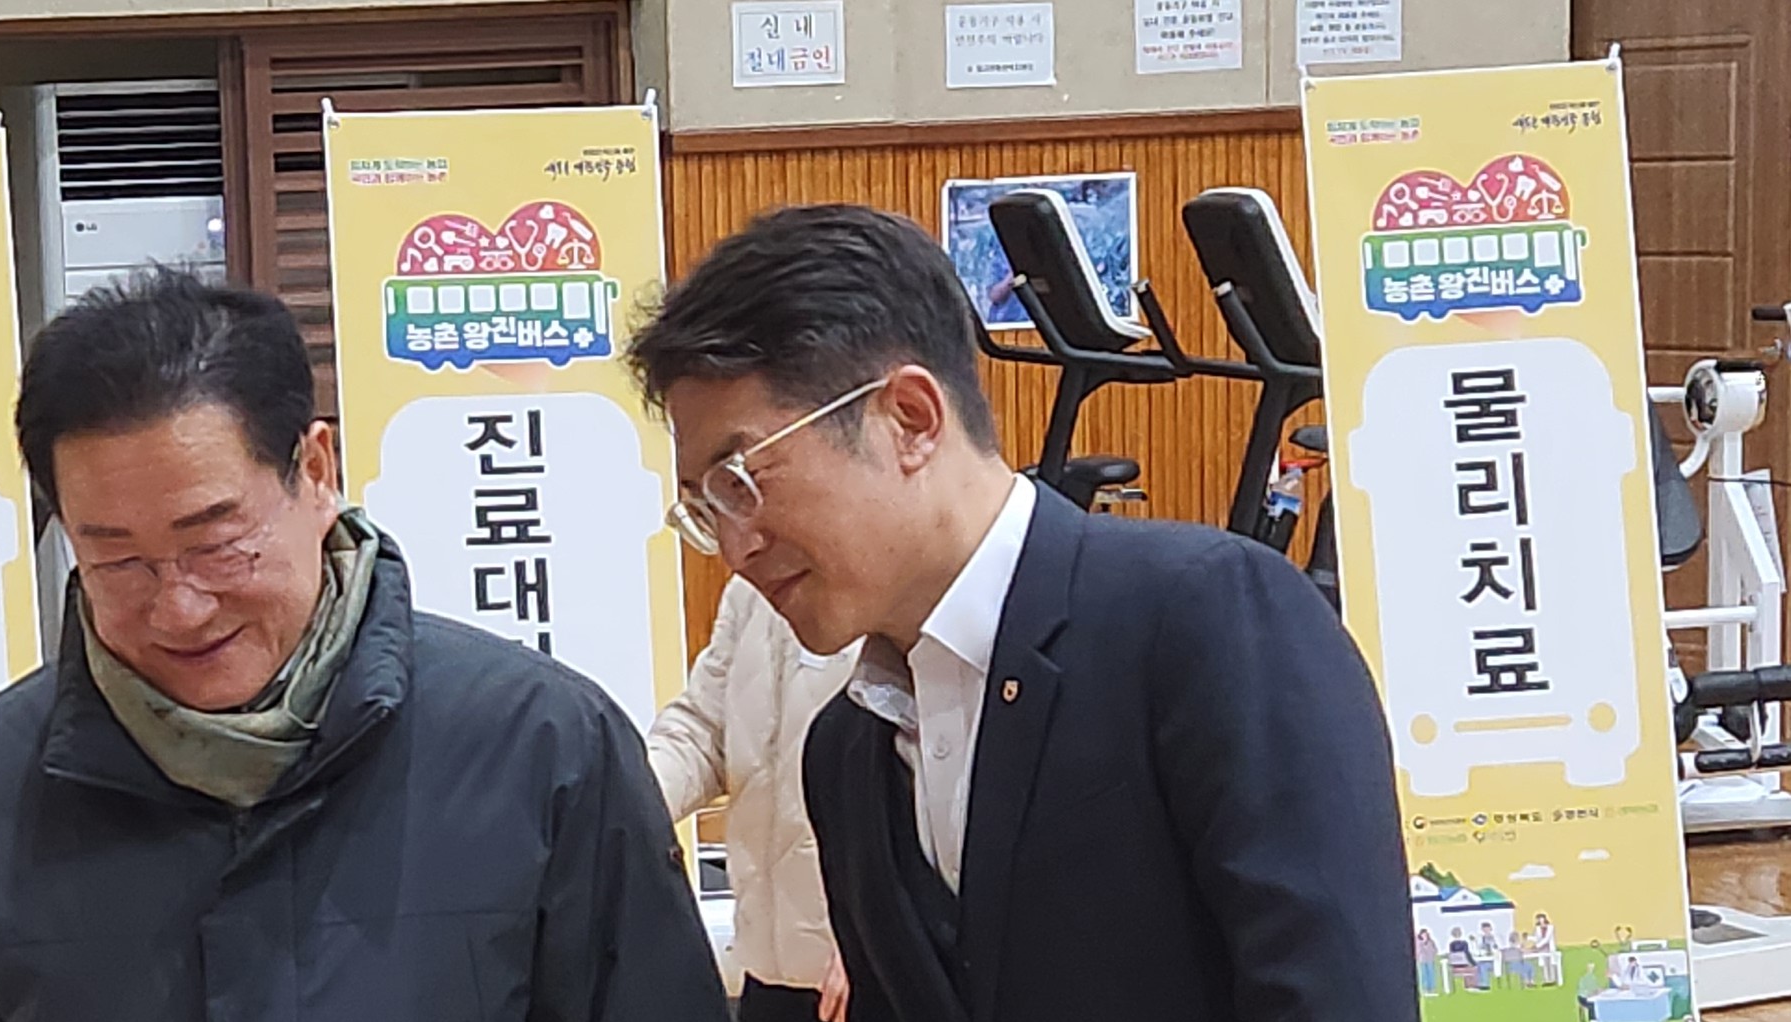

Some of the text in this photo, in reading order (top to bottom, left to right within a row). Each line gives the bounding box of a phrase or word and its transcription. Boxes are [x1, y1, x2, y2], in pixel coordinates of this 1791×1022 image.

[406, 316, 570, 351] 농촌 왕진버스
[1383, 266, 1542, 304] 농촌 왕진버스
[464, 409, 552, 657] 진료대
[1443, 368, 1550, 696] 물리치료
